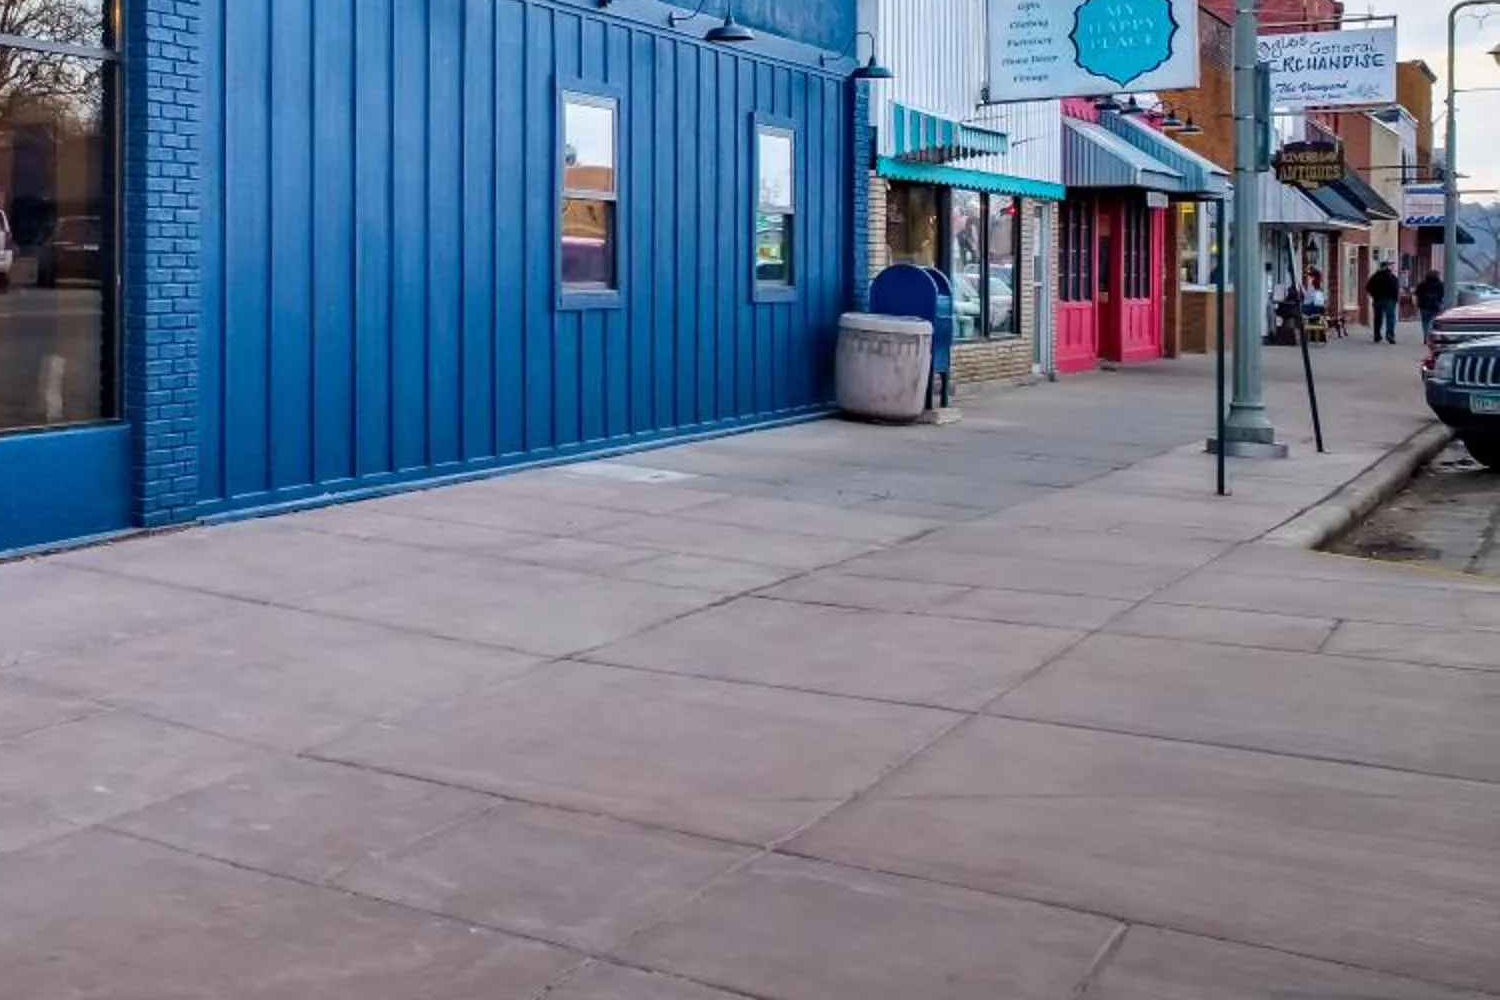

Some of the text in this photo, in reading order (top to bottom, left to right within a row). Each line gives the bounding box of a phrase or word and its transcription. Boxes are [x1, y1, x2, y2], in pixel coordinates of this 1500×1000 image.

[1106, 3, 1134, 18] MY
[1087, 16, 1157, 36] HAPPY
[1090, 33, 1157, 50] PLACE
[1308, 36, 1379, 55] General
[1281, 164, 1342, 181] ANTIQUES
